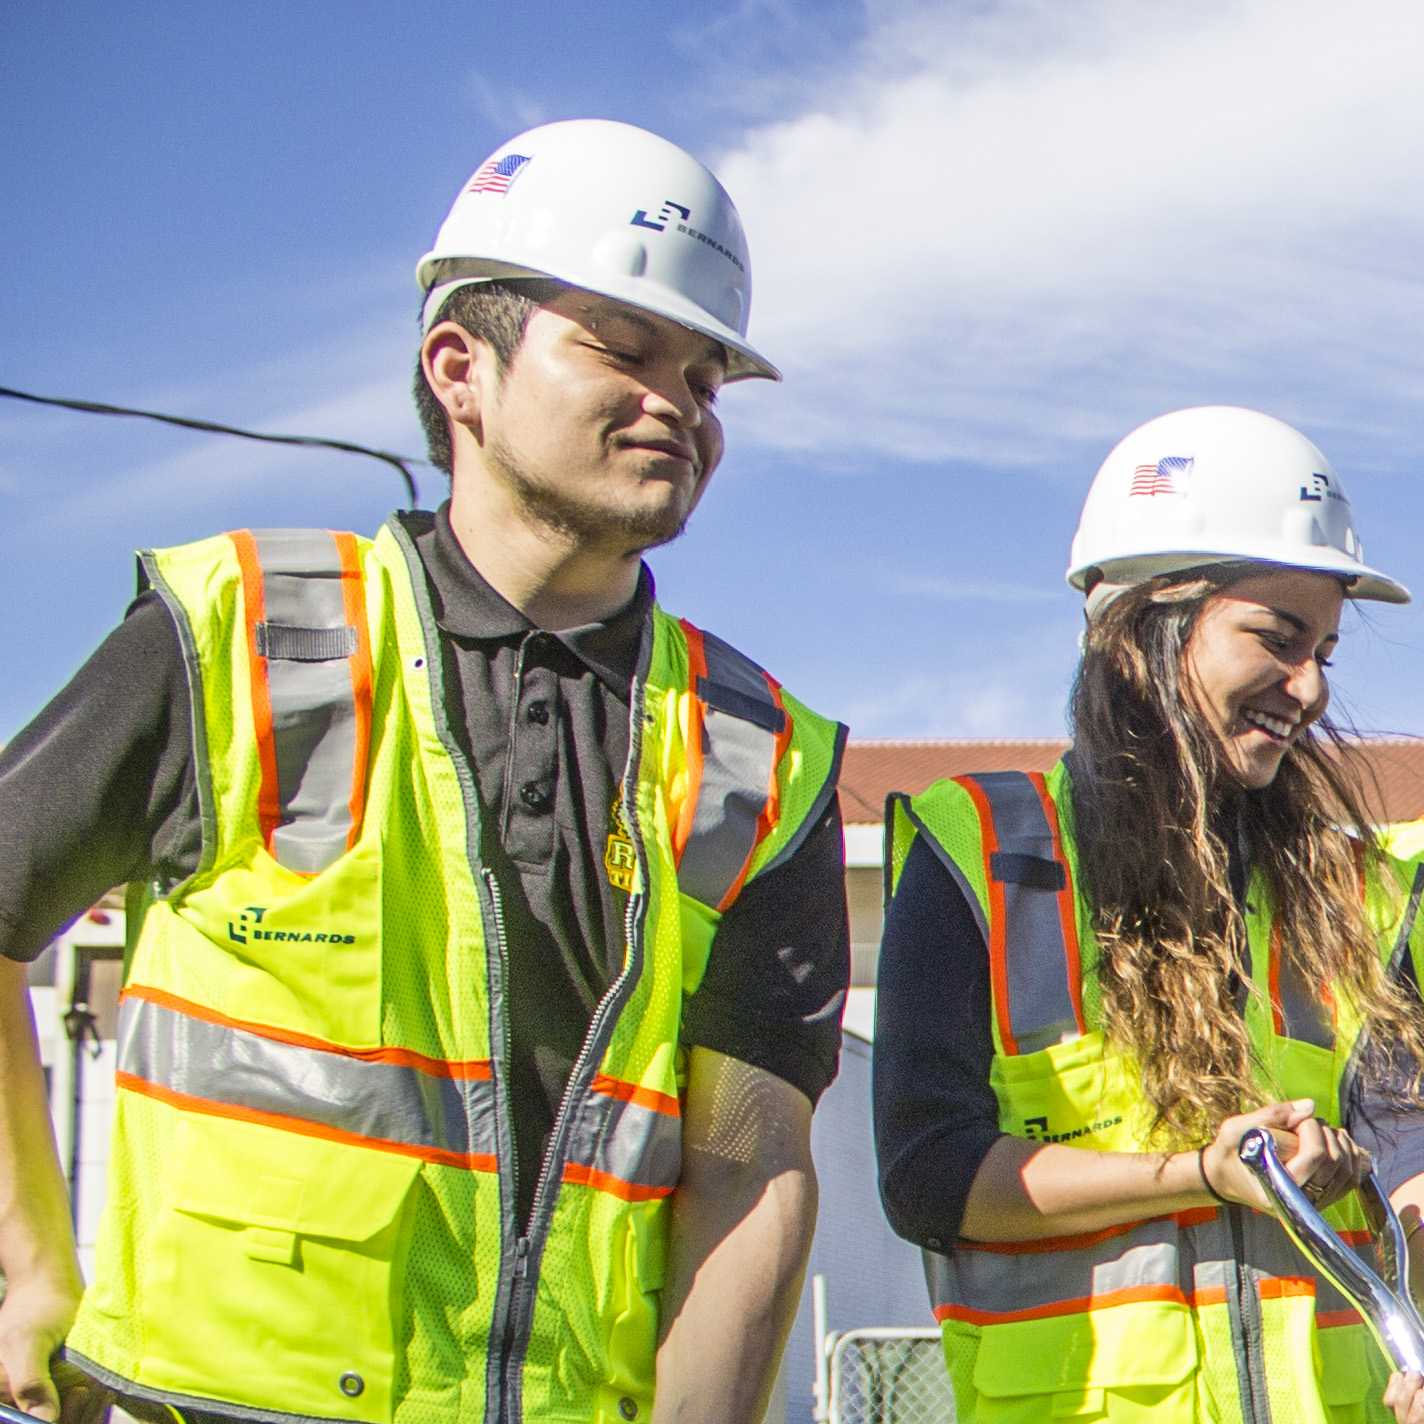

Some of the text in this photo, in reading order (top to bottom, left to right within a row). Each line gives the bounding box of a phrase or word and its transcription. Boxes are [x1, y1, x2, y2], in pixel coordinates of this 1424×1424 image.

[676, 223, 745, 272] BERNARDS
[253, 929, 357, 945] BERNARDS
[1043, 1115, 1123, 1143] BERNARDS
